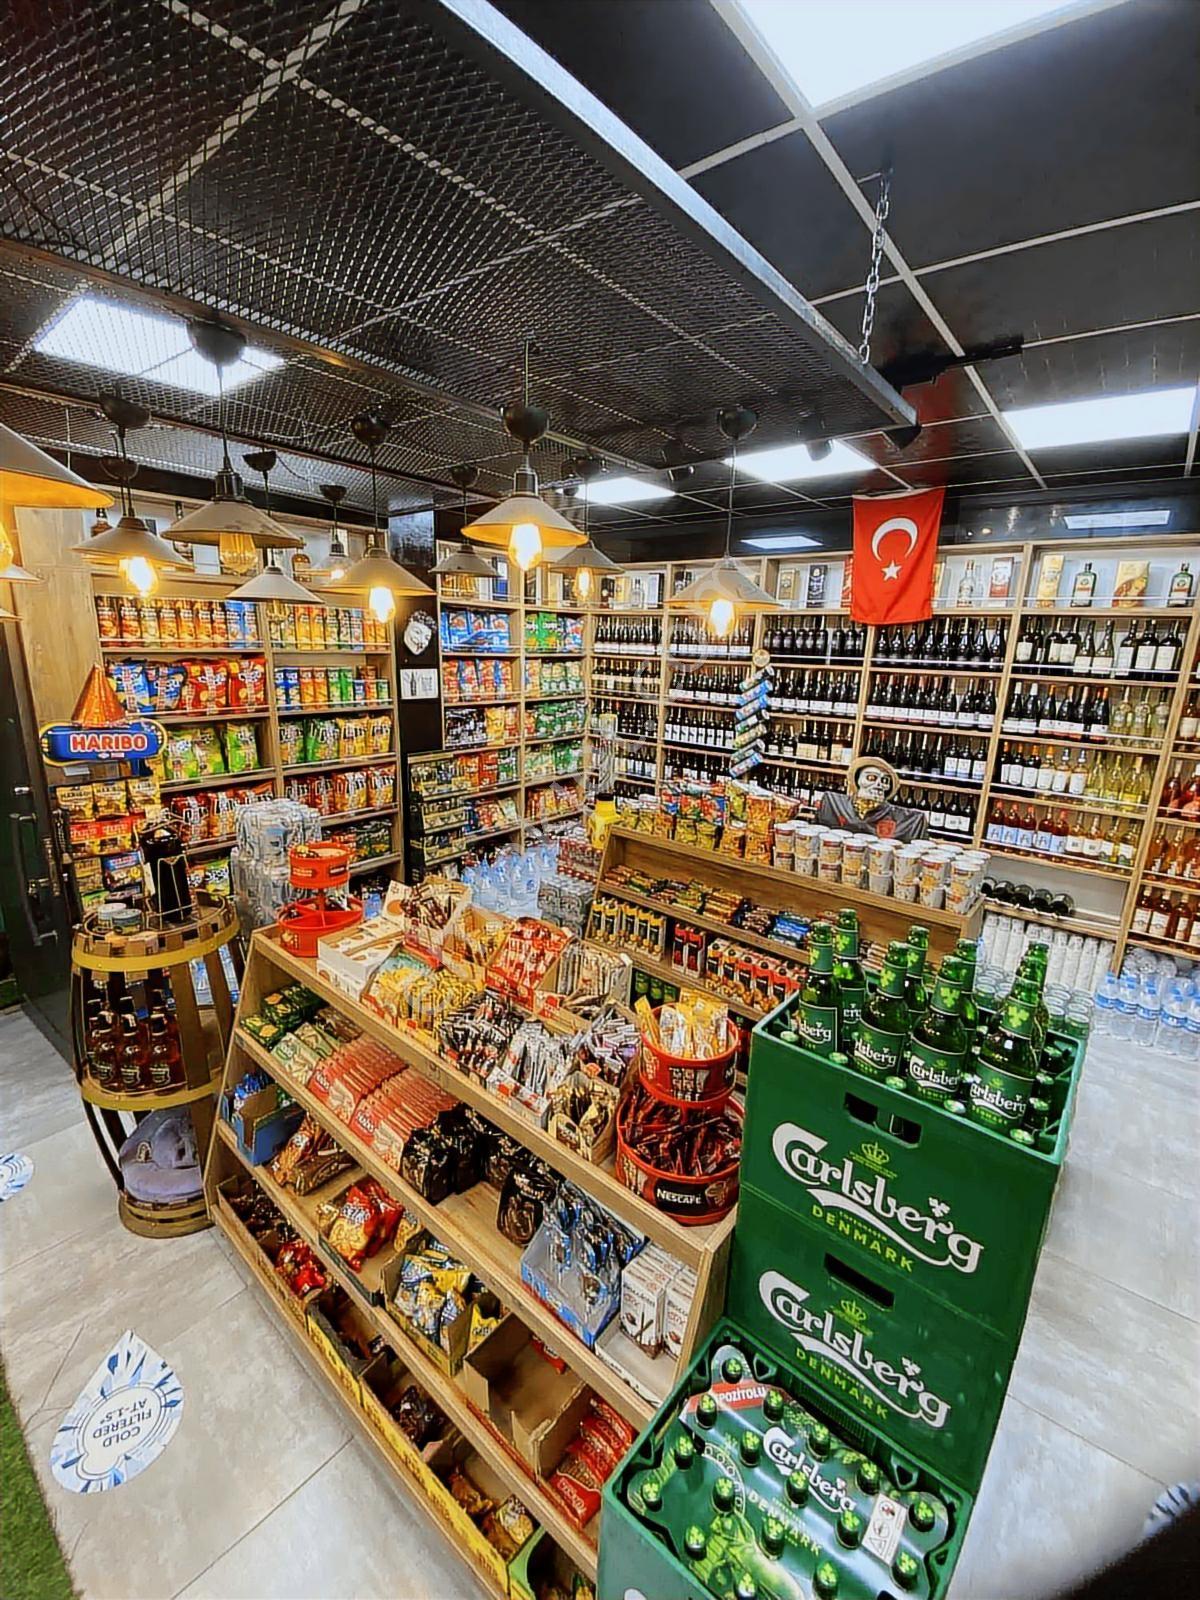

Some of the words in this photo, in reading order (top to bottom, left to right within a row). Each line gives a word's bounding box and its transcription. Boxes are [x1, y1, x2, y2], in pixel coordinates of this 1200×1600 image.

[70, 733, 148, 753] HARIBO
[909, 1054, 961, 1090] Carlsber
[771, 1122, 985, 1274] Carlsberg
[811, 1203, 915, 1273] DENMARK
[758, 1270, 952, 1428] Carlsberg
[719, 1386, 767, 1403] POZİTOLU
[795, 1347, 889, 1420] DENMARK
[92, 1408, 152, 1439] FILTERED
[102, 1425, 141, 1448] COLD
